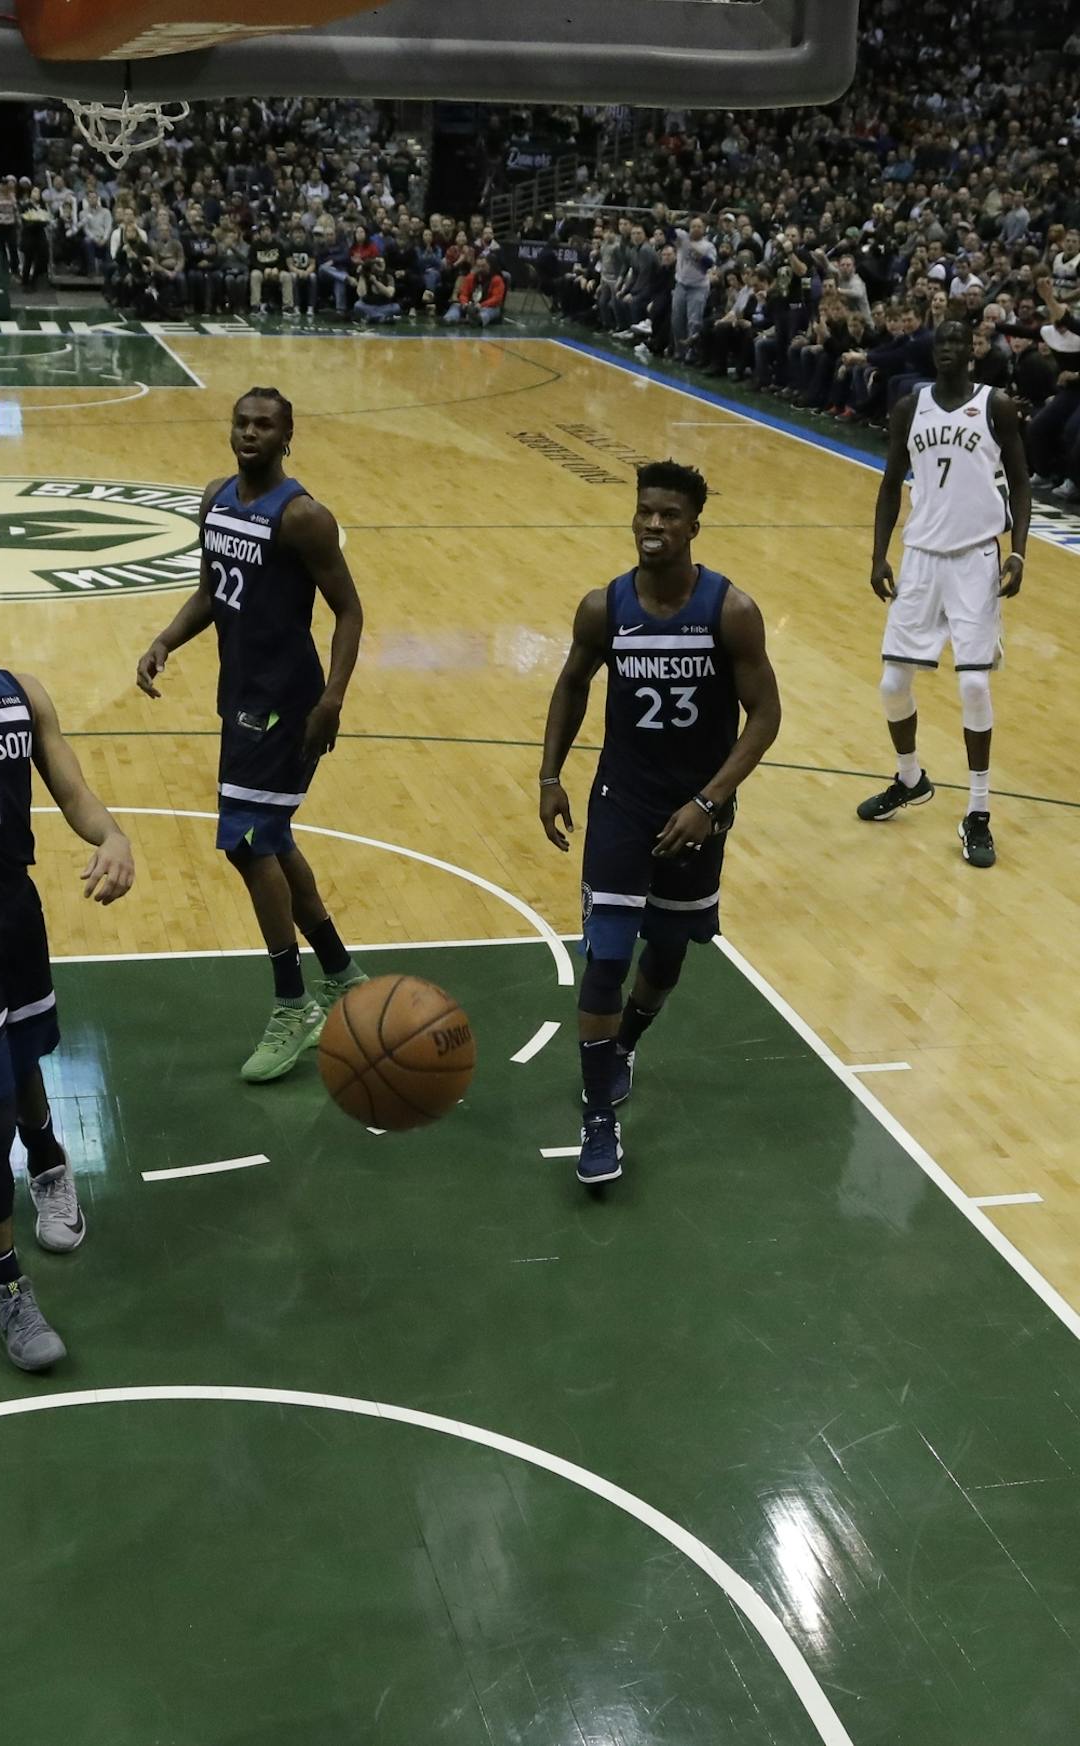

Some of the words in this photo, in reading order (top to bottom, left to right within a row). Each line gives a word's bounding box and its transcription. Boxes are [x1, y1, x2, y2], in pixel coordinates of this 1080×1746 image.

[913, 425, 981, 453] BUCKS
[937, 457, 951, 488] 7
[204, 528, 263, 566] MINNESOTA
[211, 560, 244, 611] 22
[690, 625, 709, 633] fitbit
[615, 655, 716, 679] MINNESOTA
[1, 696, 22, 706] fitbit
[634, 686, 699, 729] 23
